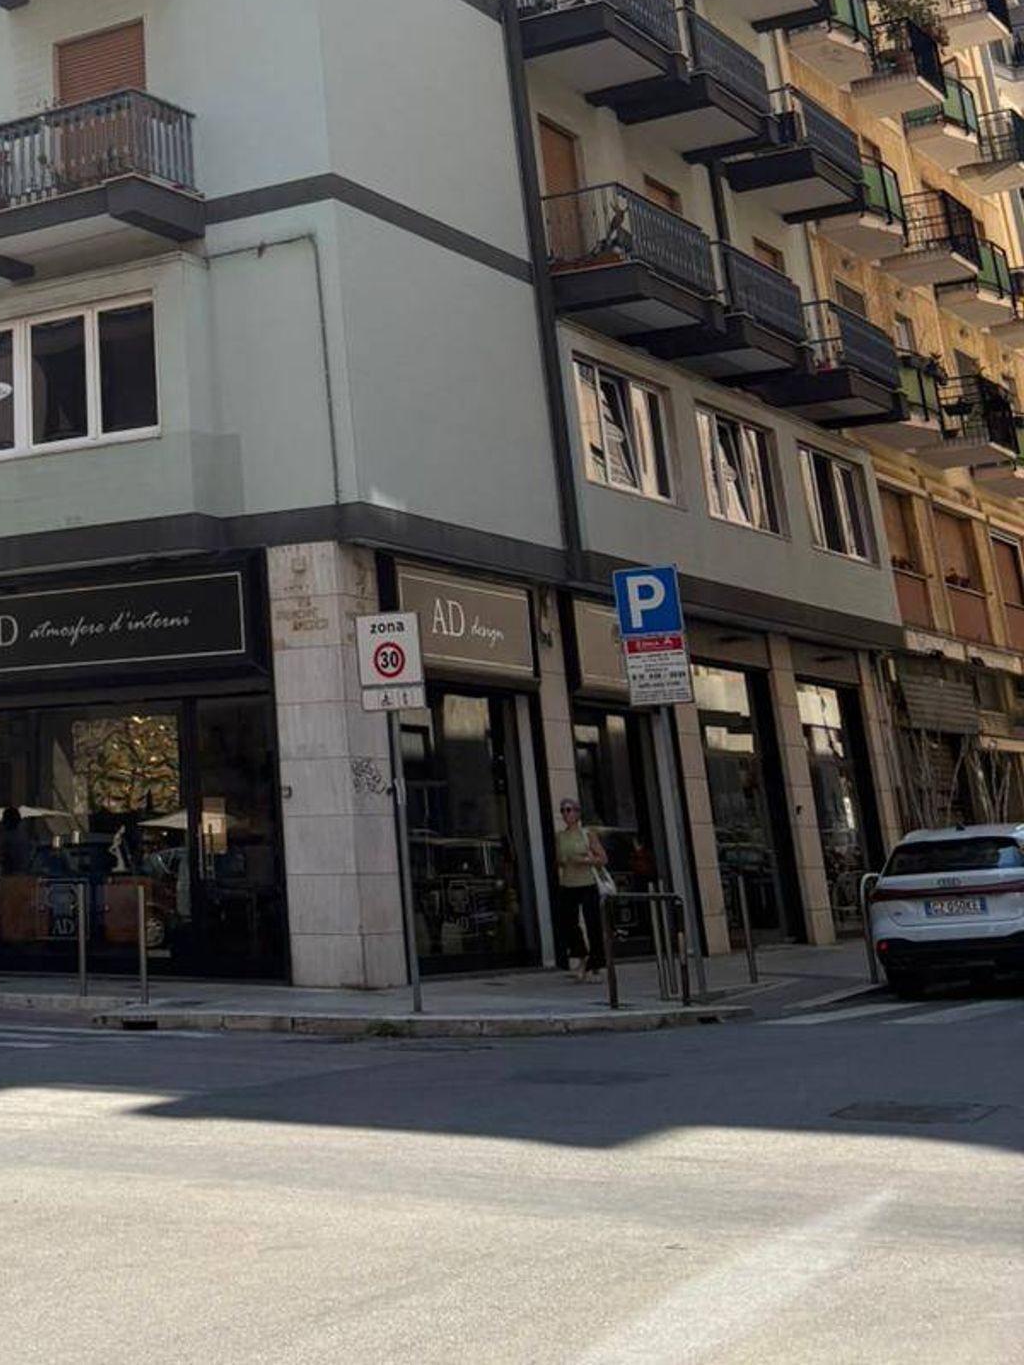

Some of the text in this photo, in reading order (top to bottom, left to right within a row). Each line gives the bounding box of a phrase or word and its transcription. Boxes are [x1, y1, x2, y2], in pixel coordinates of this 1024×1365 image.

[626, 575, 666, 629] P
[29, 617, 105, 647] atmosfere
[109, 609, 193, 633] d'interni
[370, 621, 405, 635] zona
[432, 597, 466, 638] AD
[380, 651, 400, 669] 30
[52, 918, 76, 935] AD
